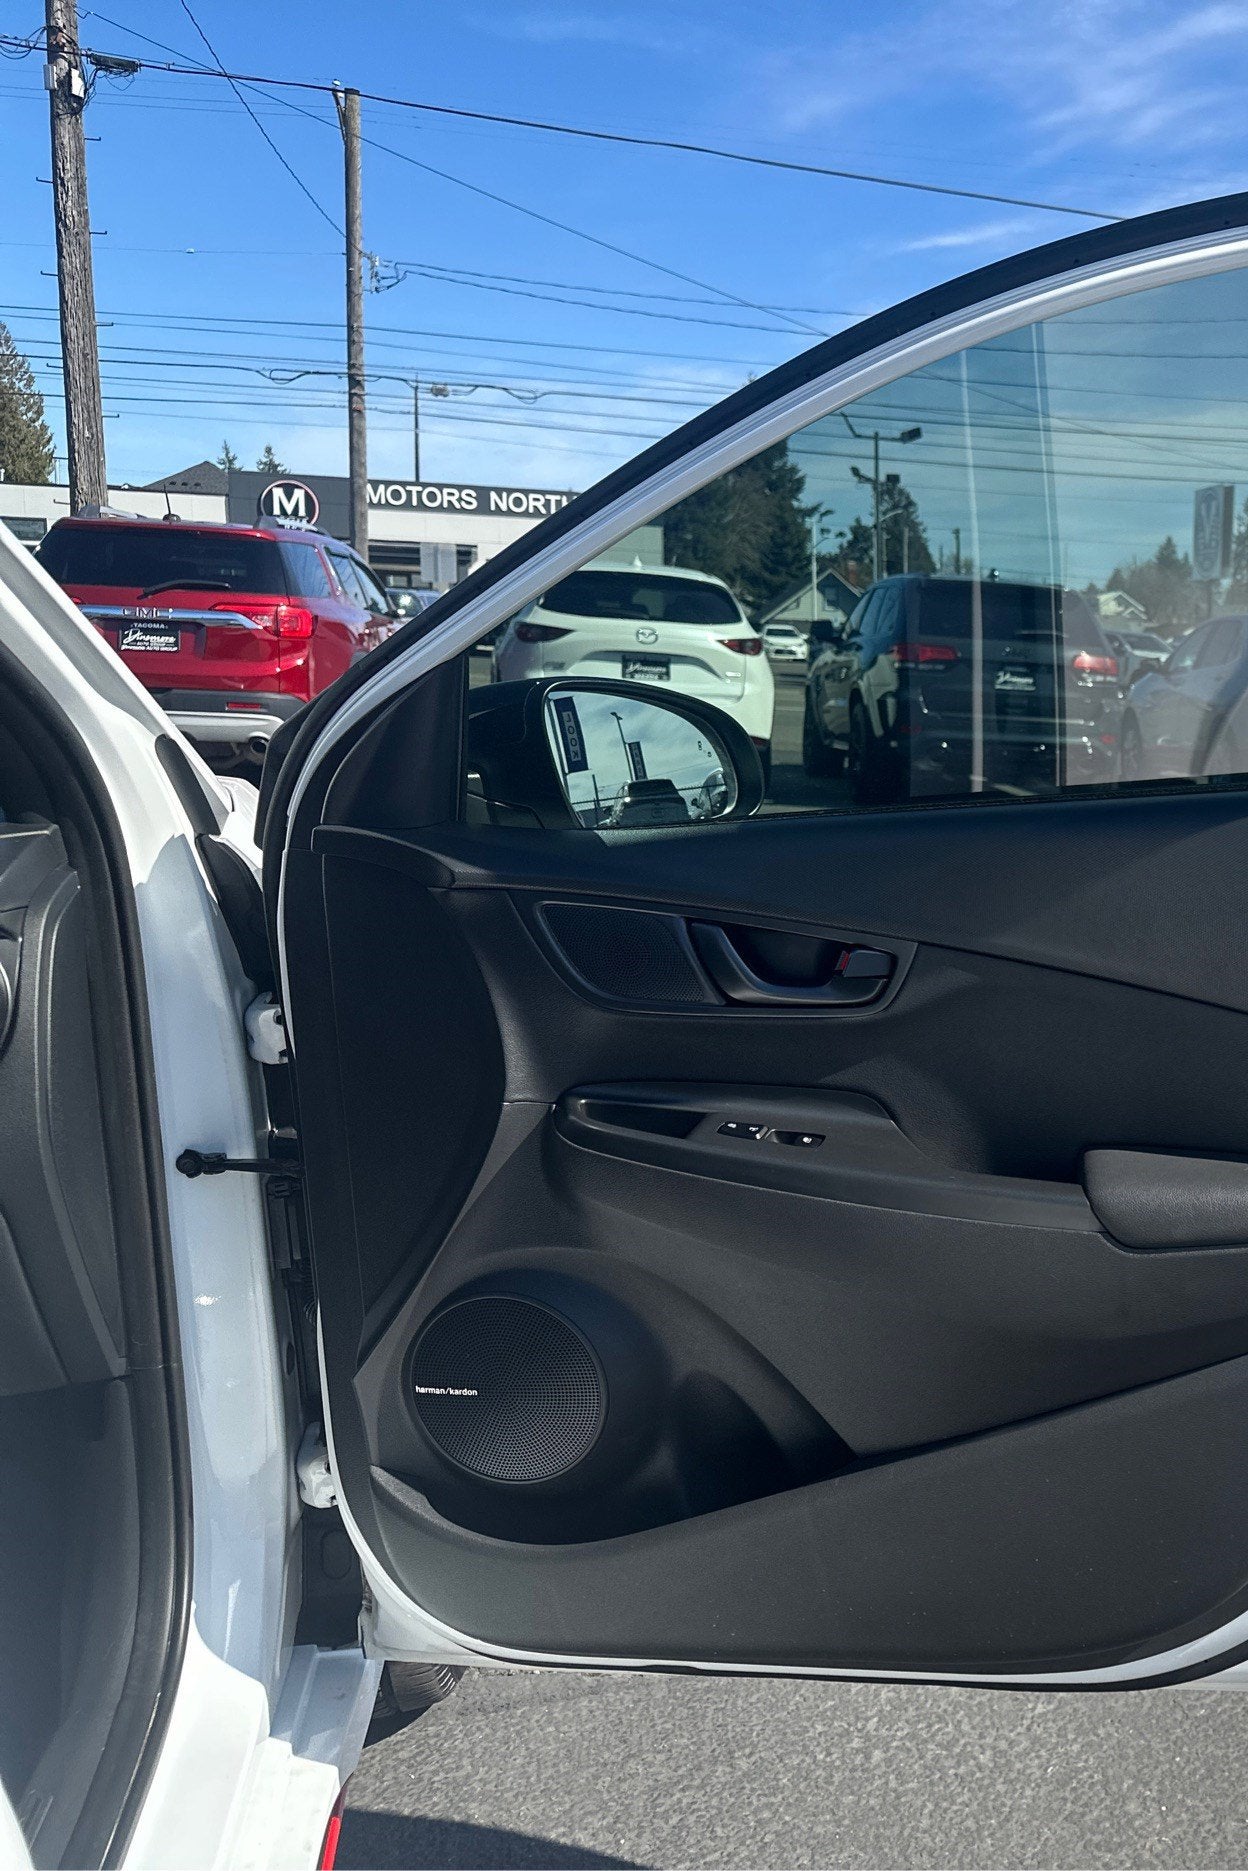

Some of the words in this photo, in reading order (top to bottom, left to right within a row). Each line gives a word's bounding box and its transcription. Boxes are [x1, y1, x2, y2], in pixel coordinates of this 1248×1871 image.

[272, 487, 306, 517] M
[366, 483, 478, 510] MOTORS
[415, 1385, 478, 1396] harman/kardon
